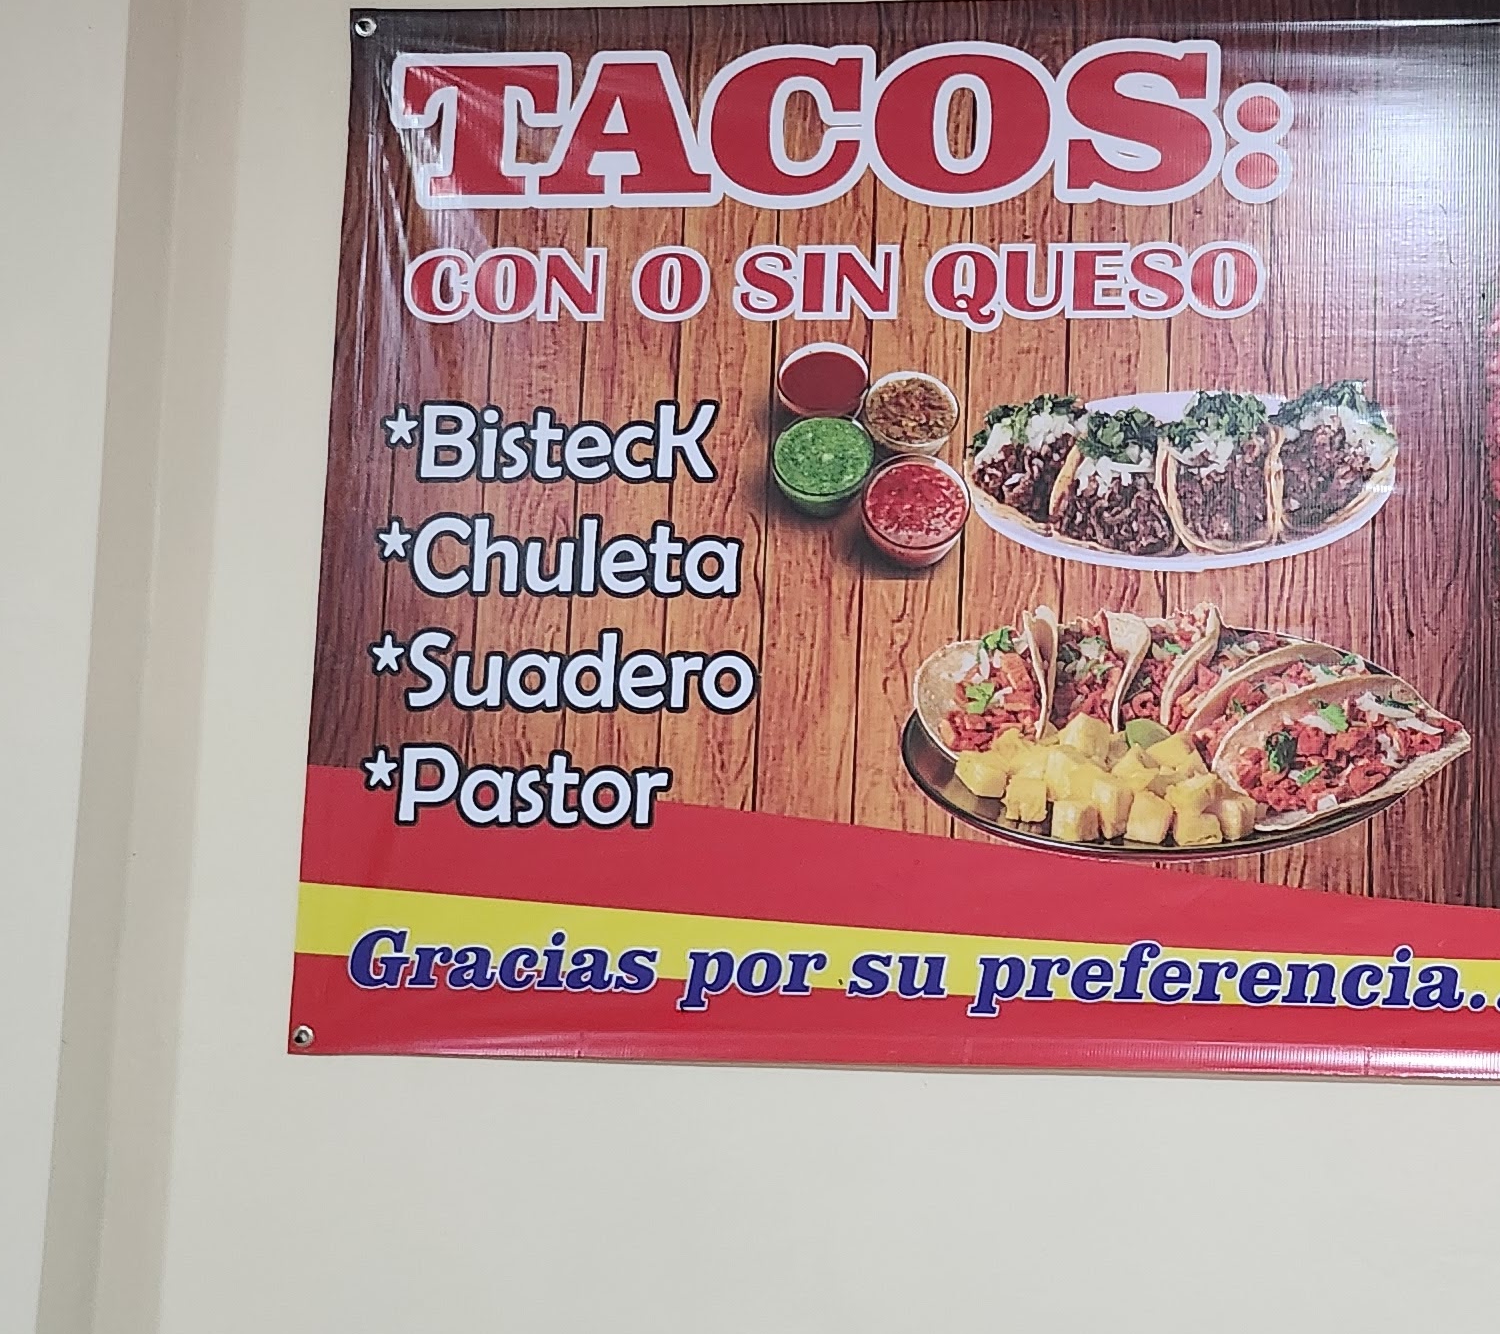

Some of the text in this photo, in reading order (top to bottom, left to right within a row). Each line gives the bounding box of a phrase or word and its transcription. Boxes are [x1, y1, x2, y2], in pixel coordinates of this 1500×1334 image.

[391, 39, 1294, 208] TACOS:
[404, 241, 1266, 332] CON O SIN QUESO
[349, 928, 659, 993] Gracias
[677, 946, 825, 1012] por
[848, 953, 945, 999] su
